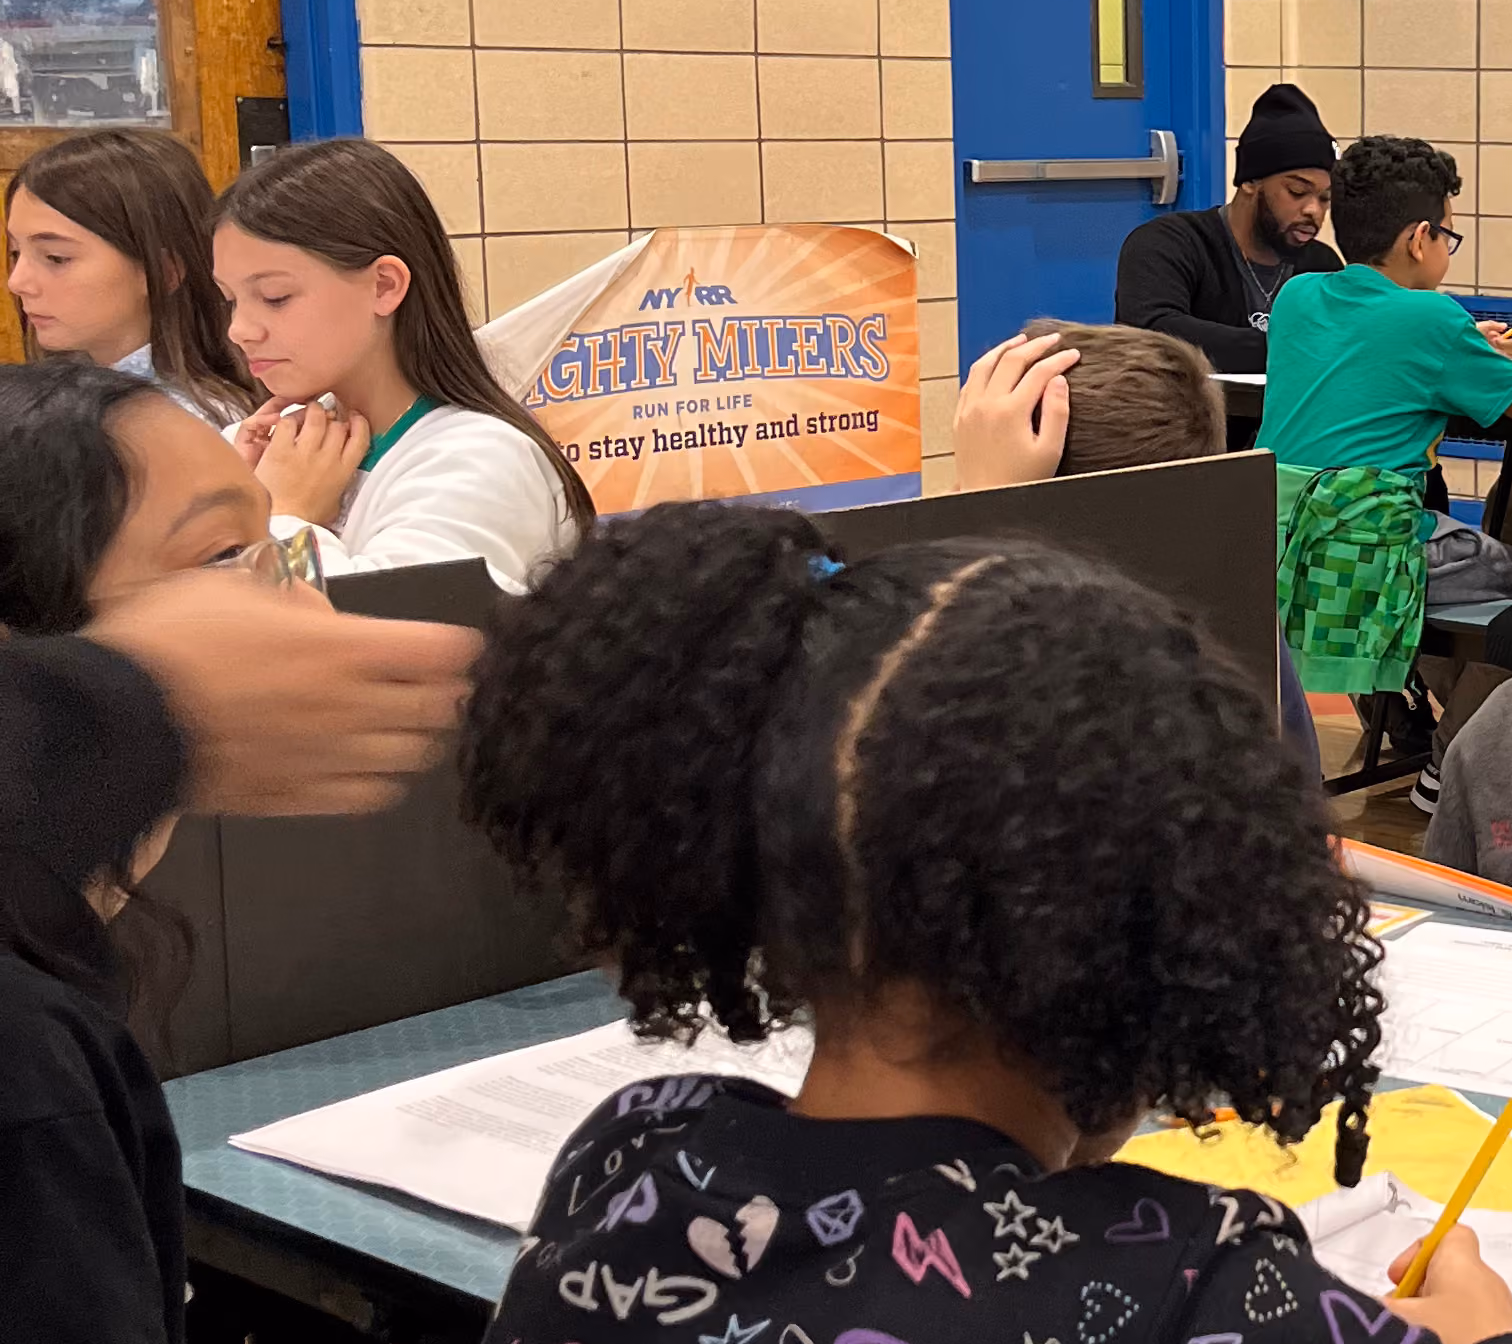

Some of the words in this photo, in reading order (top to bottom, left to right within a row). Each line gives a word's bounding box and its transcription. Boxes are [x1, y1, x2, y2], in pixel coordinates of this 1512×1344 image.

[694, 312, 891, 385] MILERS
[556, 441, 581, 464] to
[588, 433, 645, 462] stay
[652, 420, 750, 455] healthy
[756, 414, 801, 442] and
[806, 408, 880, 437] strong
[632, 403, 672, 420] RUN
[676, 398, 711, 416] FOR
[716, 394, 753, 411] LIFE
[558, 1259, 719, 1326] GAP
